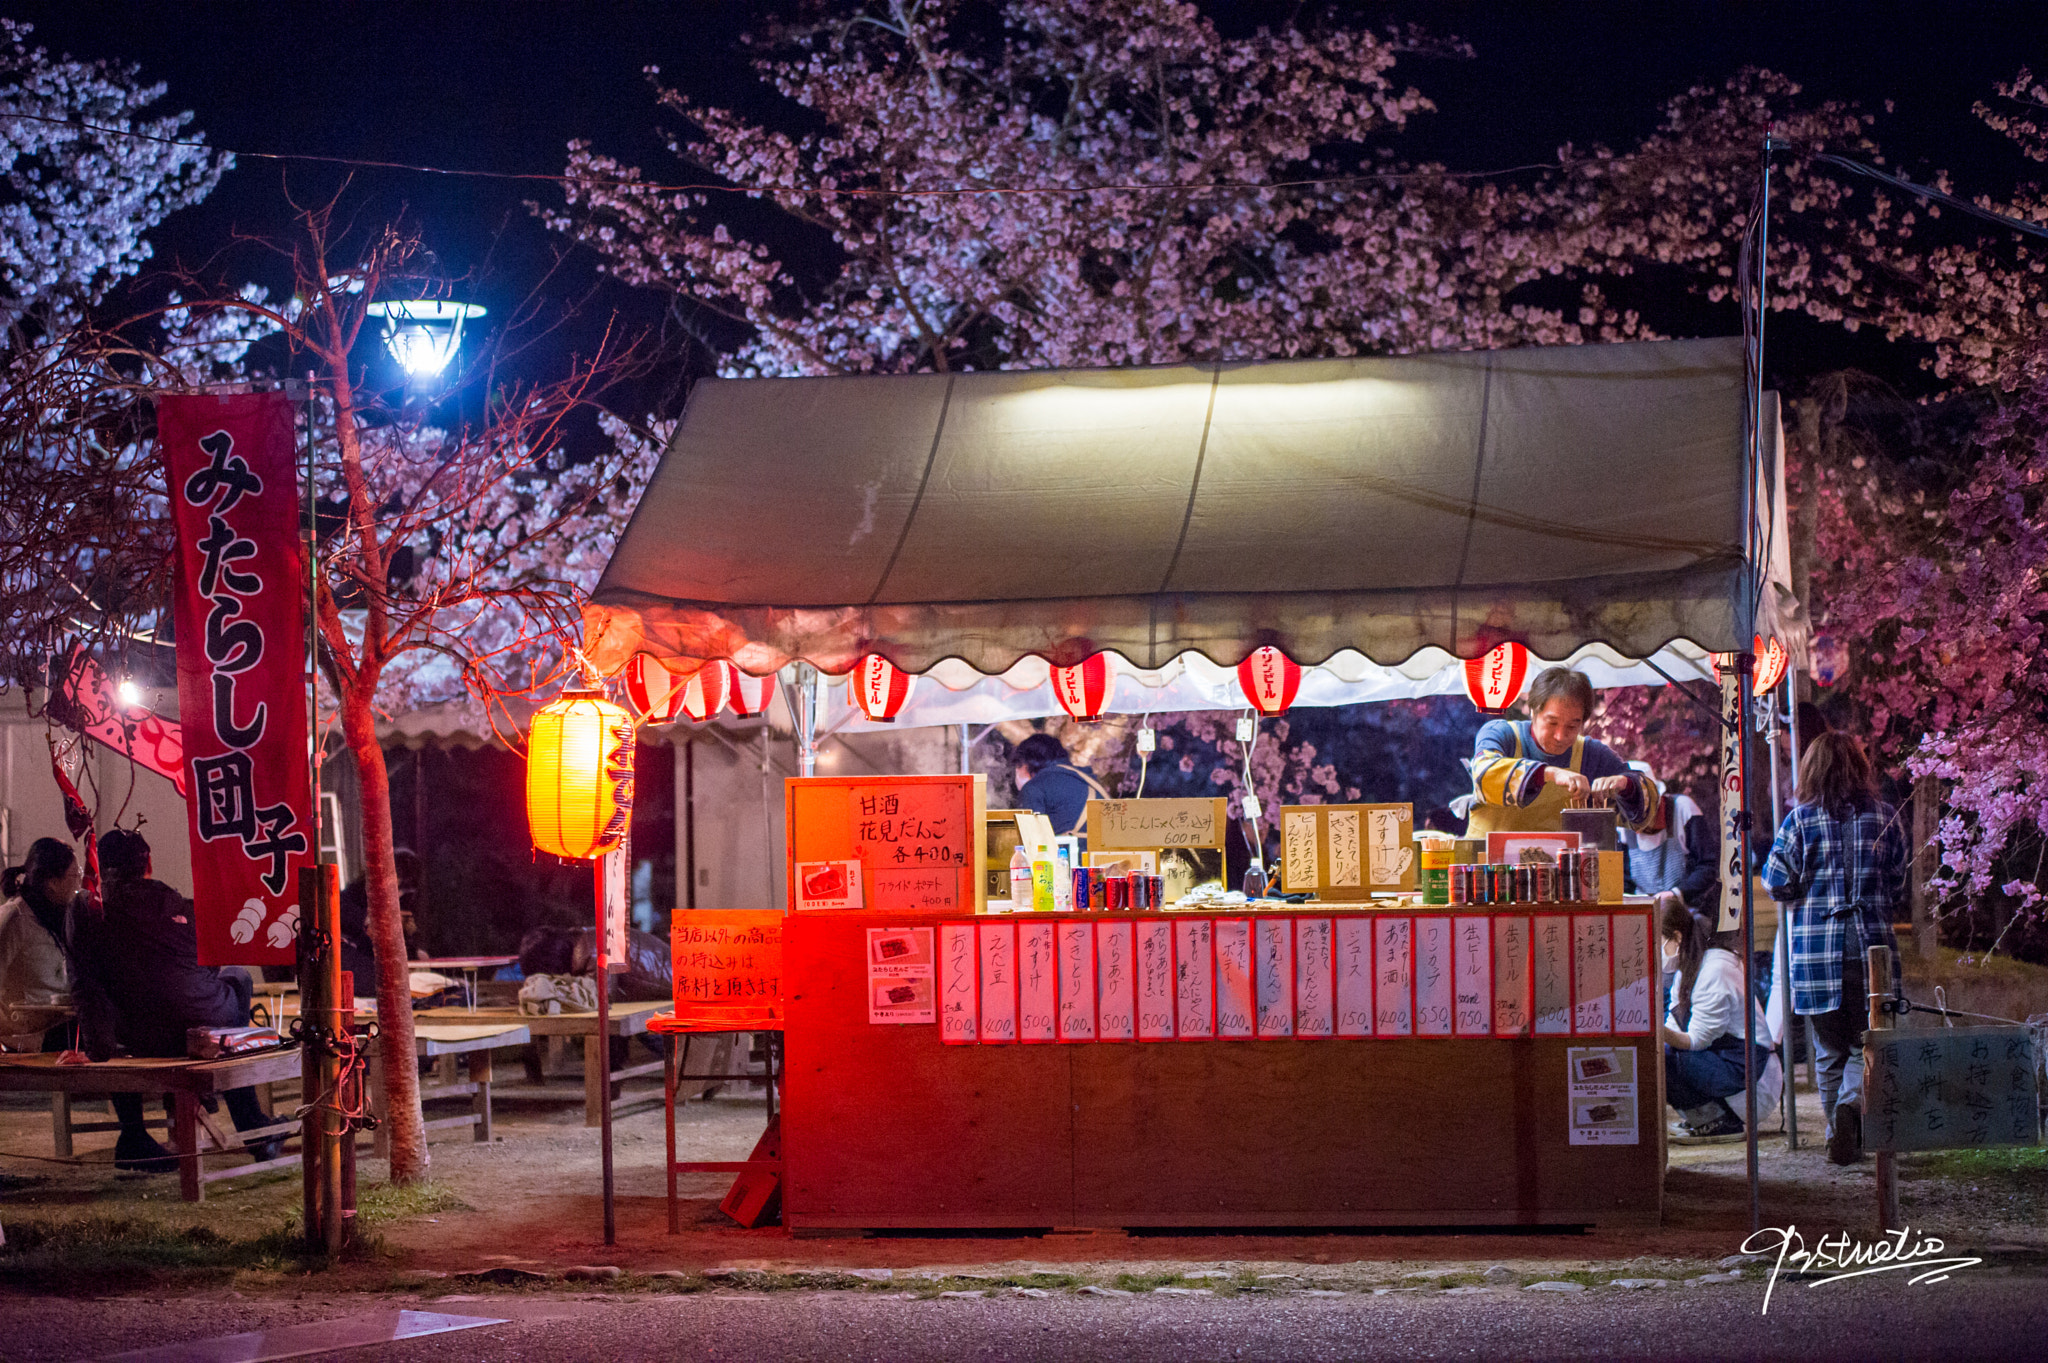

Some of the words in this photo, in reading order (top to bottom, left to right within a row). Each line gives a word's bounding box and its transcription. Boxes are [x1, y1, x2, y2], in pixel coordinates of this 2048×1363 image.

[184, 429, 307, 897] みたらし団子
[1065, 666, 1080, 704] ンビール
[860, 794, 899, 816] 甘酒
[859, 817, 947, 843] 花見だんご
[1164, 833, 1201, 844] 600円
[678, 927, 782, 945] 当店以外の商品
[1347, 930, 1362, 977] ジュース
[1464, 924, 1482, 975] 生ビール
[1504, 924, 1520, 982] 生ビール
[676, 952, 754, 970] の持込みは
[948, 933, 971, 993] おでん
[1065, 929, 1085, 996] やきとり
[1108, 932, 1124, 995] からあげ
